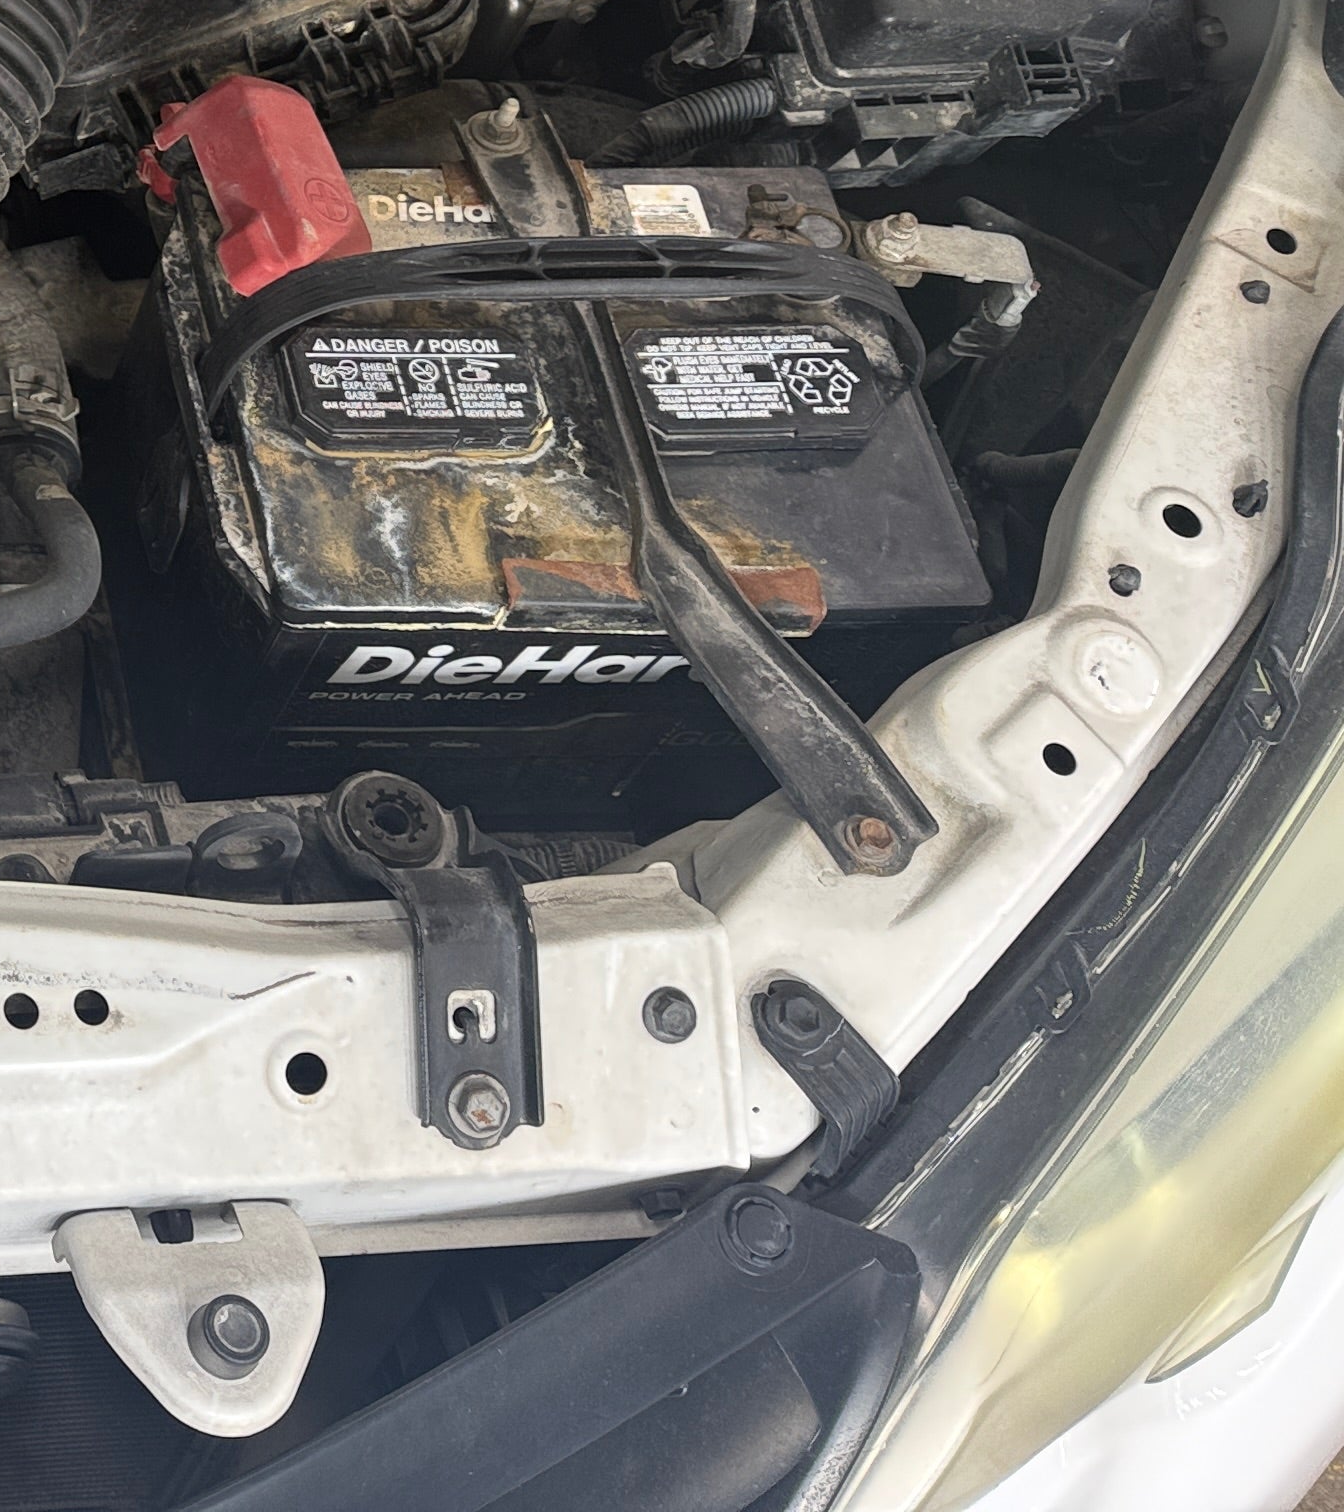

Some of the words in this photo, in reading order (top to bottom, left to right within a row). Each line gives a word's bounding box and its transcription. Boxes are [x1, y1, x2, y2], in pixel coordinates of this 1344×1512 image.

[330, 338, 411, 353] DANGER
[428, 338, 501, 353] POISON
[360, 362, 394, 372] SHIELD
[417, 382, 436, 393] NO
[326, 643, 702, 685] DieHar
[307, 691, 415, 702] POWER
[422, 691, 527, 702] AHEAD
